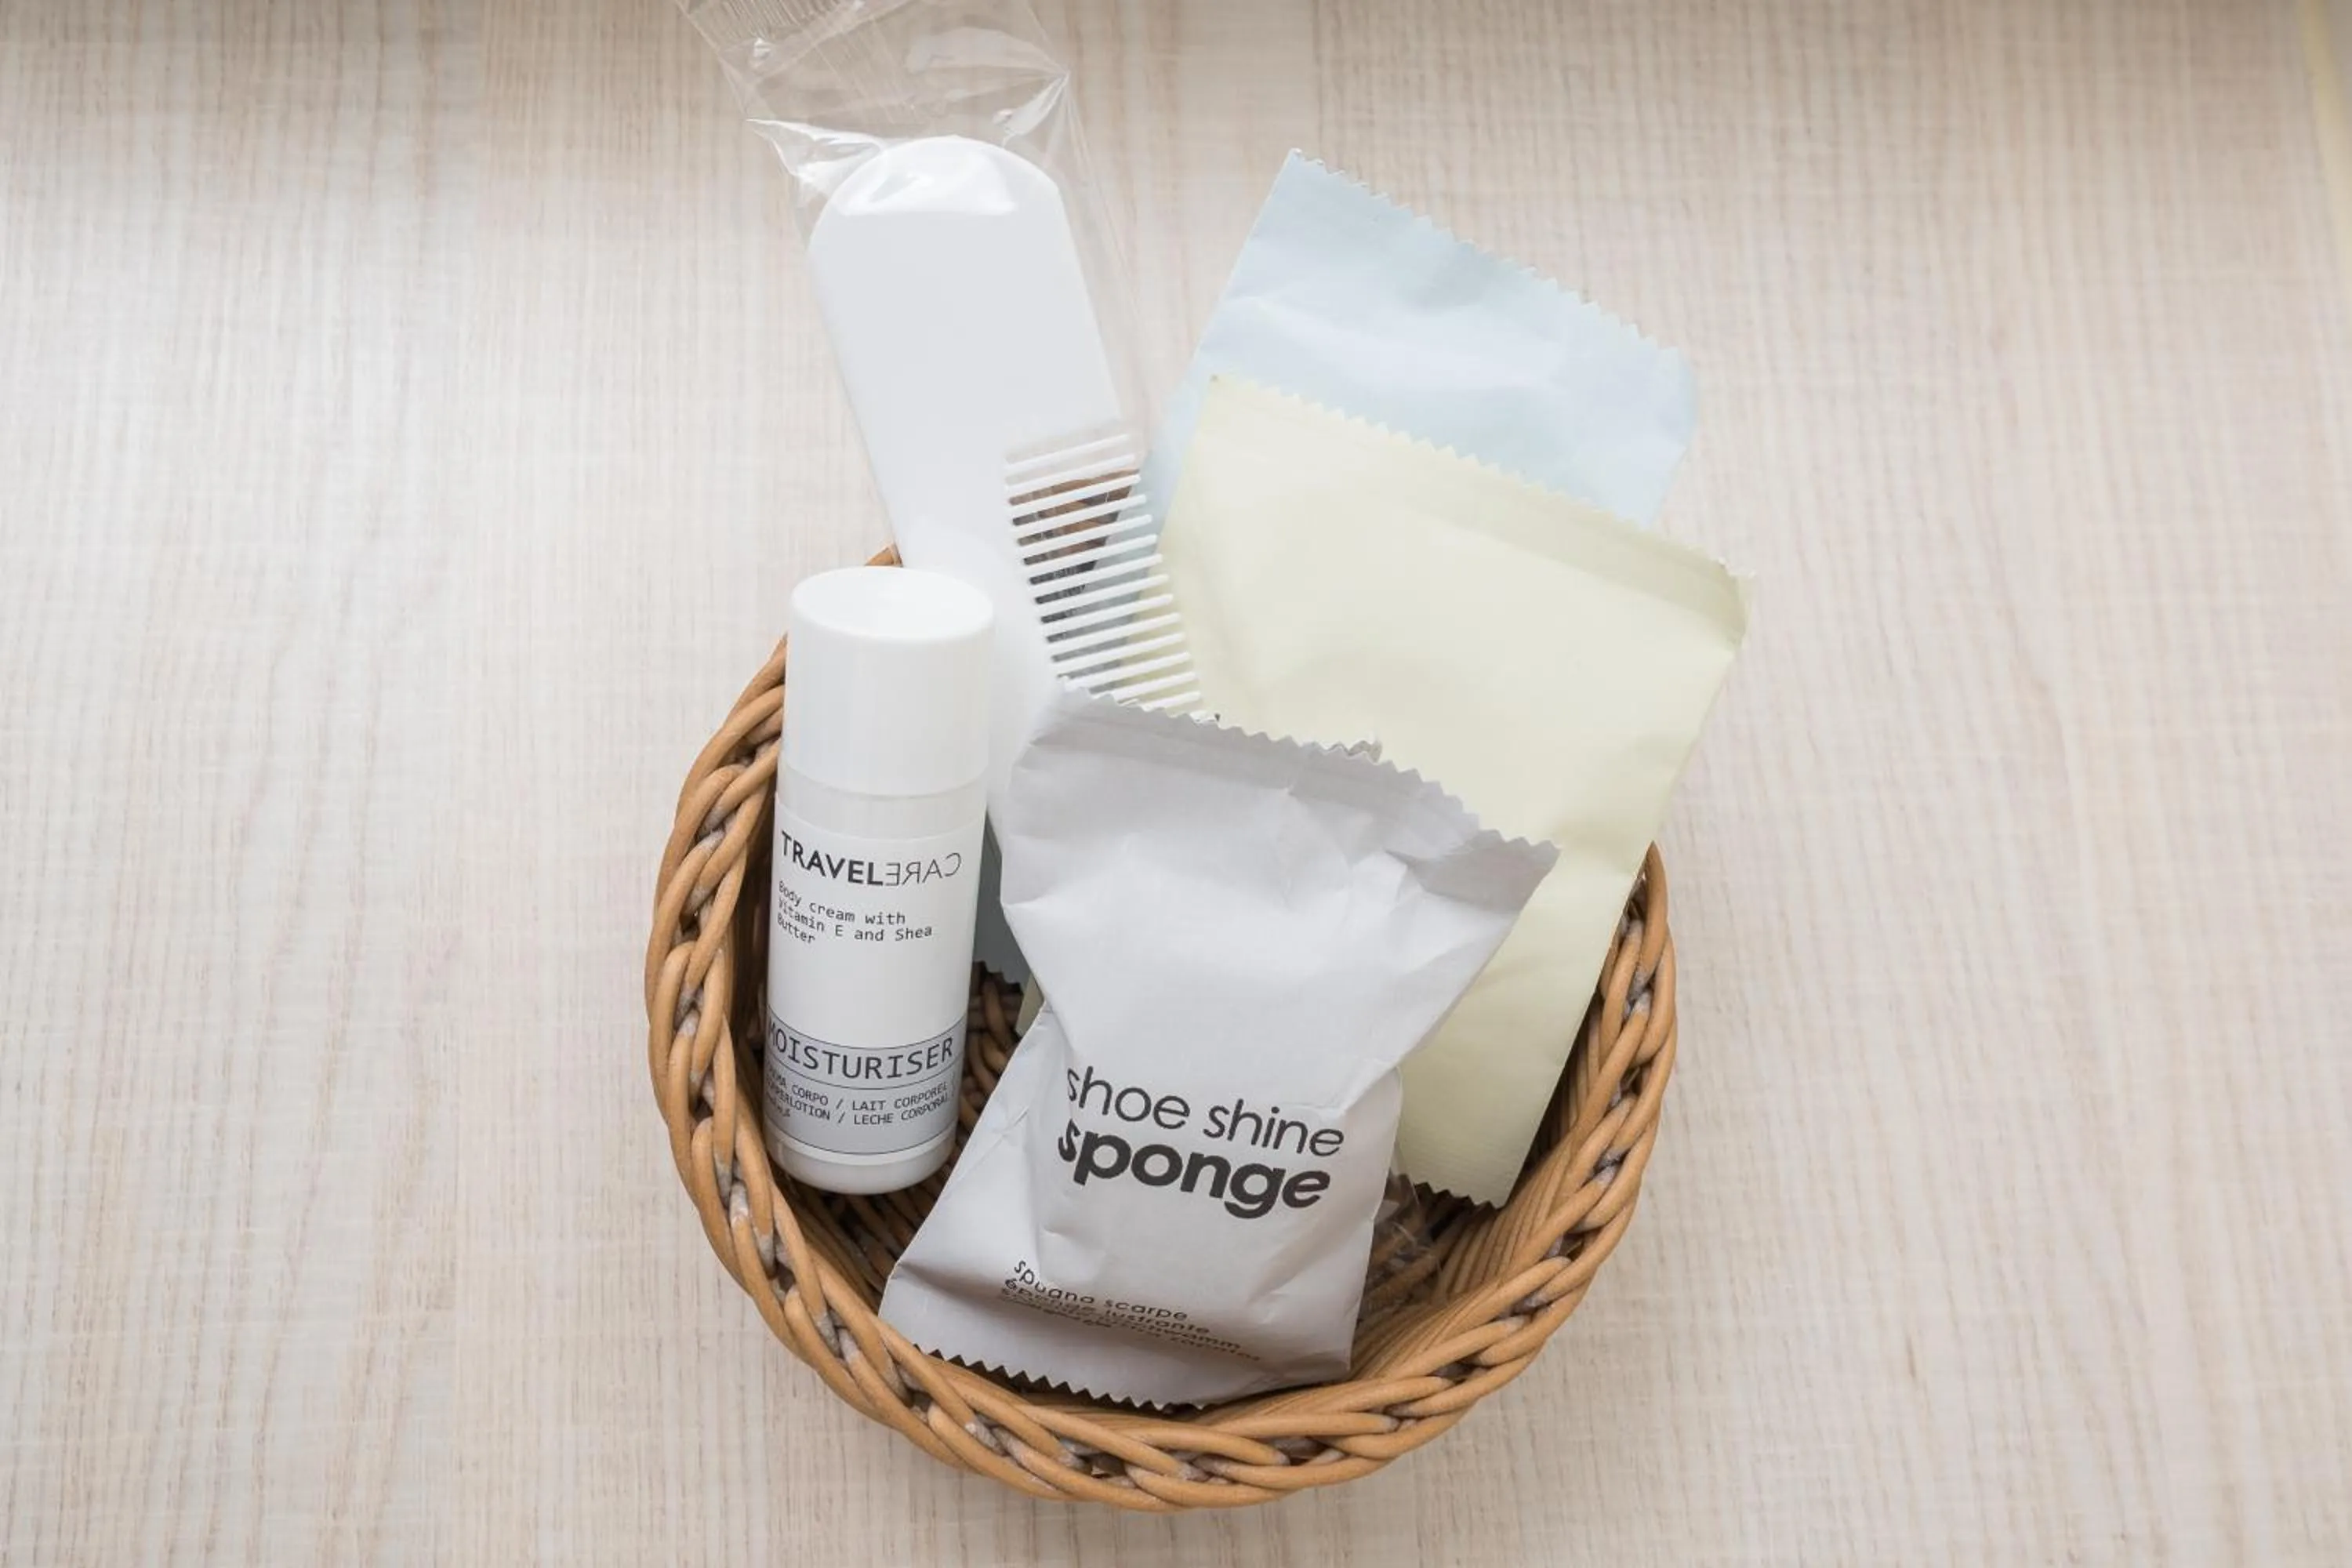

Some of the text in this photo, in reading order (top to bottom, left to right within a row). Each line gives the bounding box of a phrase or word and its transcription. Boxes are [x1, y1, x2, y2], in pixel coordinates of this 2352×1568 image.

[782, 830, 883, 886] TRAVEL
[779, 880, 906, 925] Body cream with
[779, 898, 932, 942] Vitamin E and Shea
[777, 913, 815, 944] Butter
[792, 1084, 828, 1106] CORPO
[836, 1098, 844, 1109] /
[852, 1099, 886, 1112] LAIT
[838, 1112, 845, 1123] /
[854, 1113, 894, 1125] LECHE
[1067, 1065, 1345, 1157] shoe shine
[1058, 1118, 1330, 1219] sponge
[1103, 1298, 1188, 1320] scarpe
